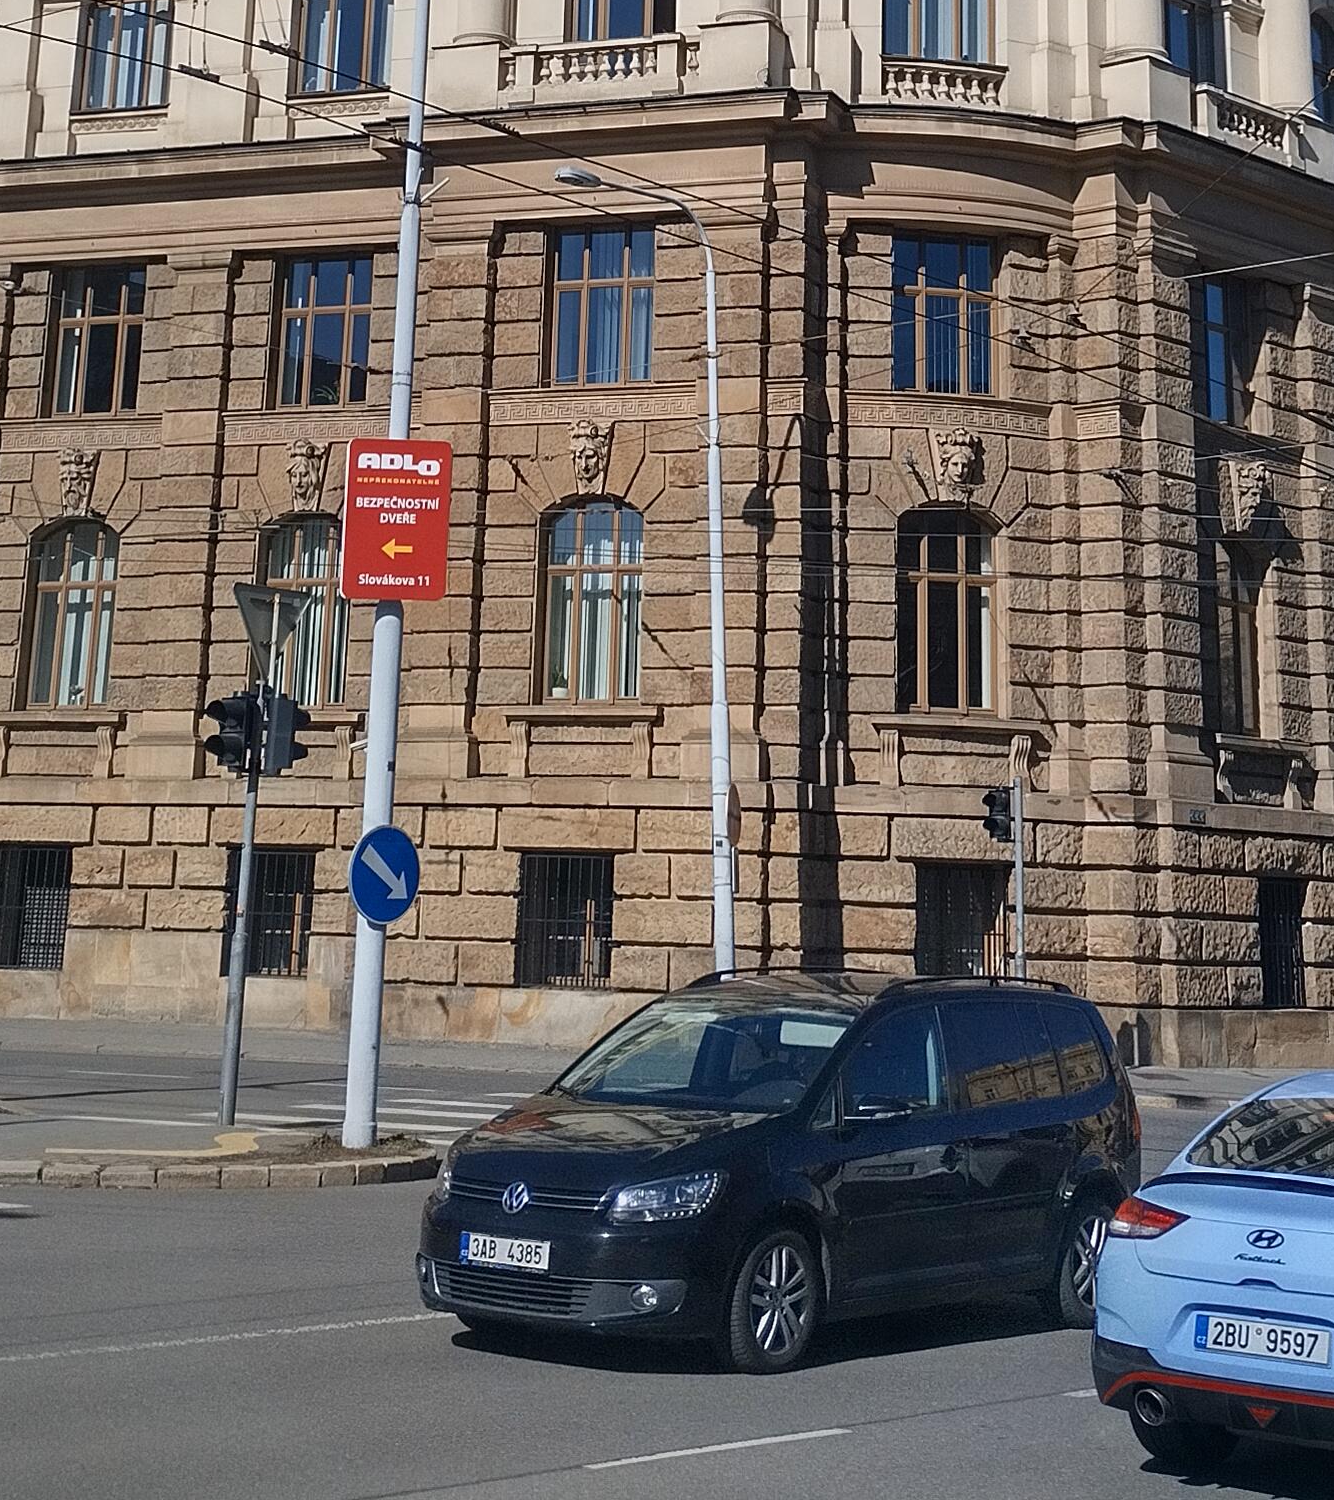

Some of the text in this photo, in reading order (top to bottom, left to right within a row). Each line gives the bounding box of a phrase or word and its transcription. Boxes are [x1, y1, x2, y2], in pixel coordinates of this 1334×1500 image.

[357, 453, 441, 476] ADLO
[355, 496, 440, 510] BEZPEČNOSTNÍ
[379, 511, 416, 524] DVEŘE
[358, 573, 430, 586] Slovákova 11
[471, 1238, 497, 1259] 3AB
[507, 1242, 543, 1265] 4385
[1212, 1321, 1250, 1349] 2BU
[1266, 1328, 1319, 1358] 9597
